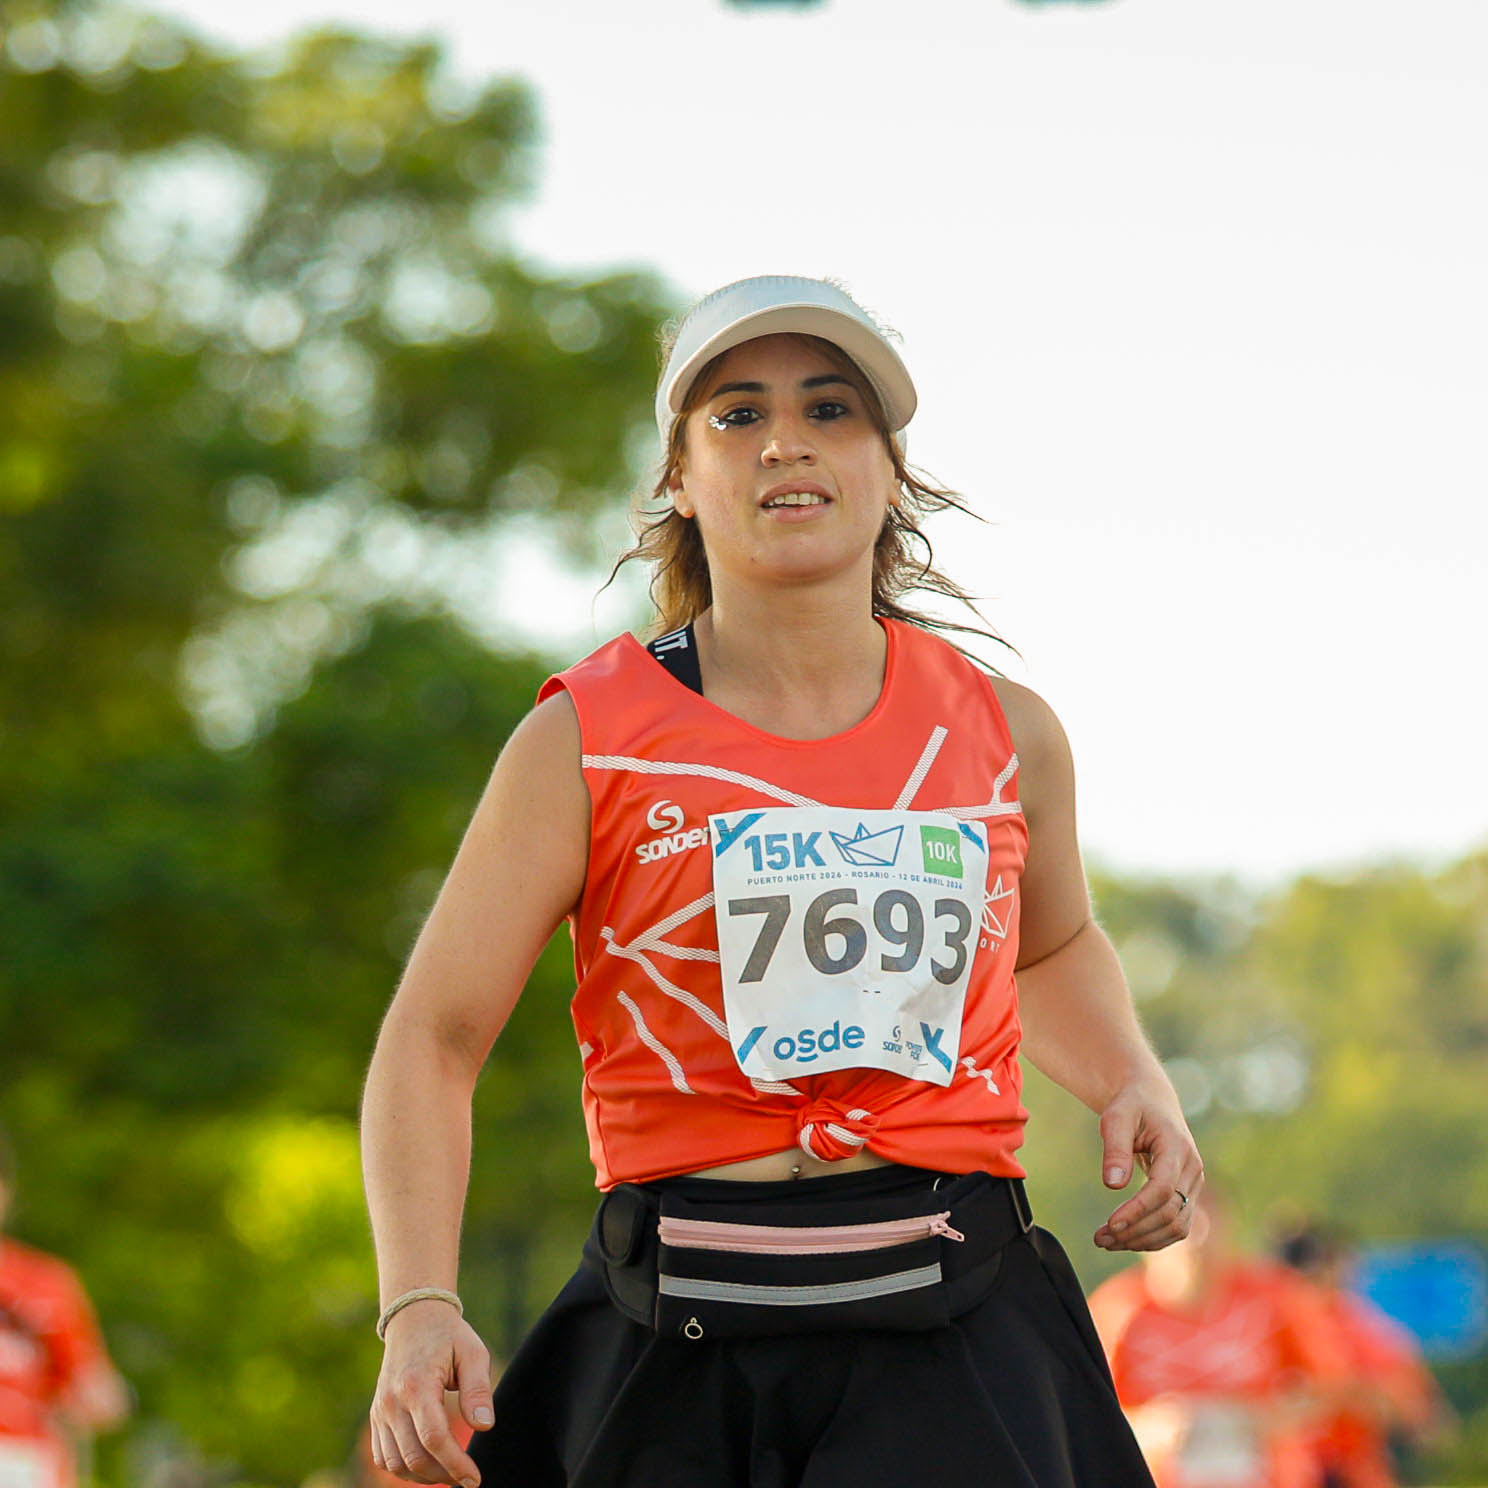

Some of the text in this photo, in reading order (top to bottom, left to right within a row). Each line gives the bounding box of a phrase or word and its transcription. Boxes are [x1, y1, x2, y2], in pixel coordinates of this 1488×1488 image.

[744, 831, 827, 872] 15K
[925, 840, 958, 864] 10K
[747, 875, 784, 885] PUERTO
[786, 872, 817, 882] NORTE
[851, 871, 890, 880] ROSARIO
[898, 873, 908, 881] 12
[910, 874, 921, 883] DE
[923, 876, 945, 887] ABRIL
[728, 887, 972, 986] 7693
[773, 1019, 866, 1063] osde
